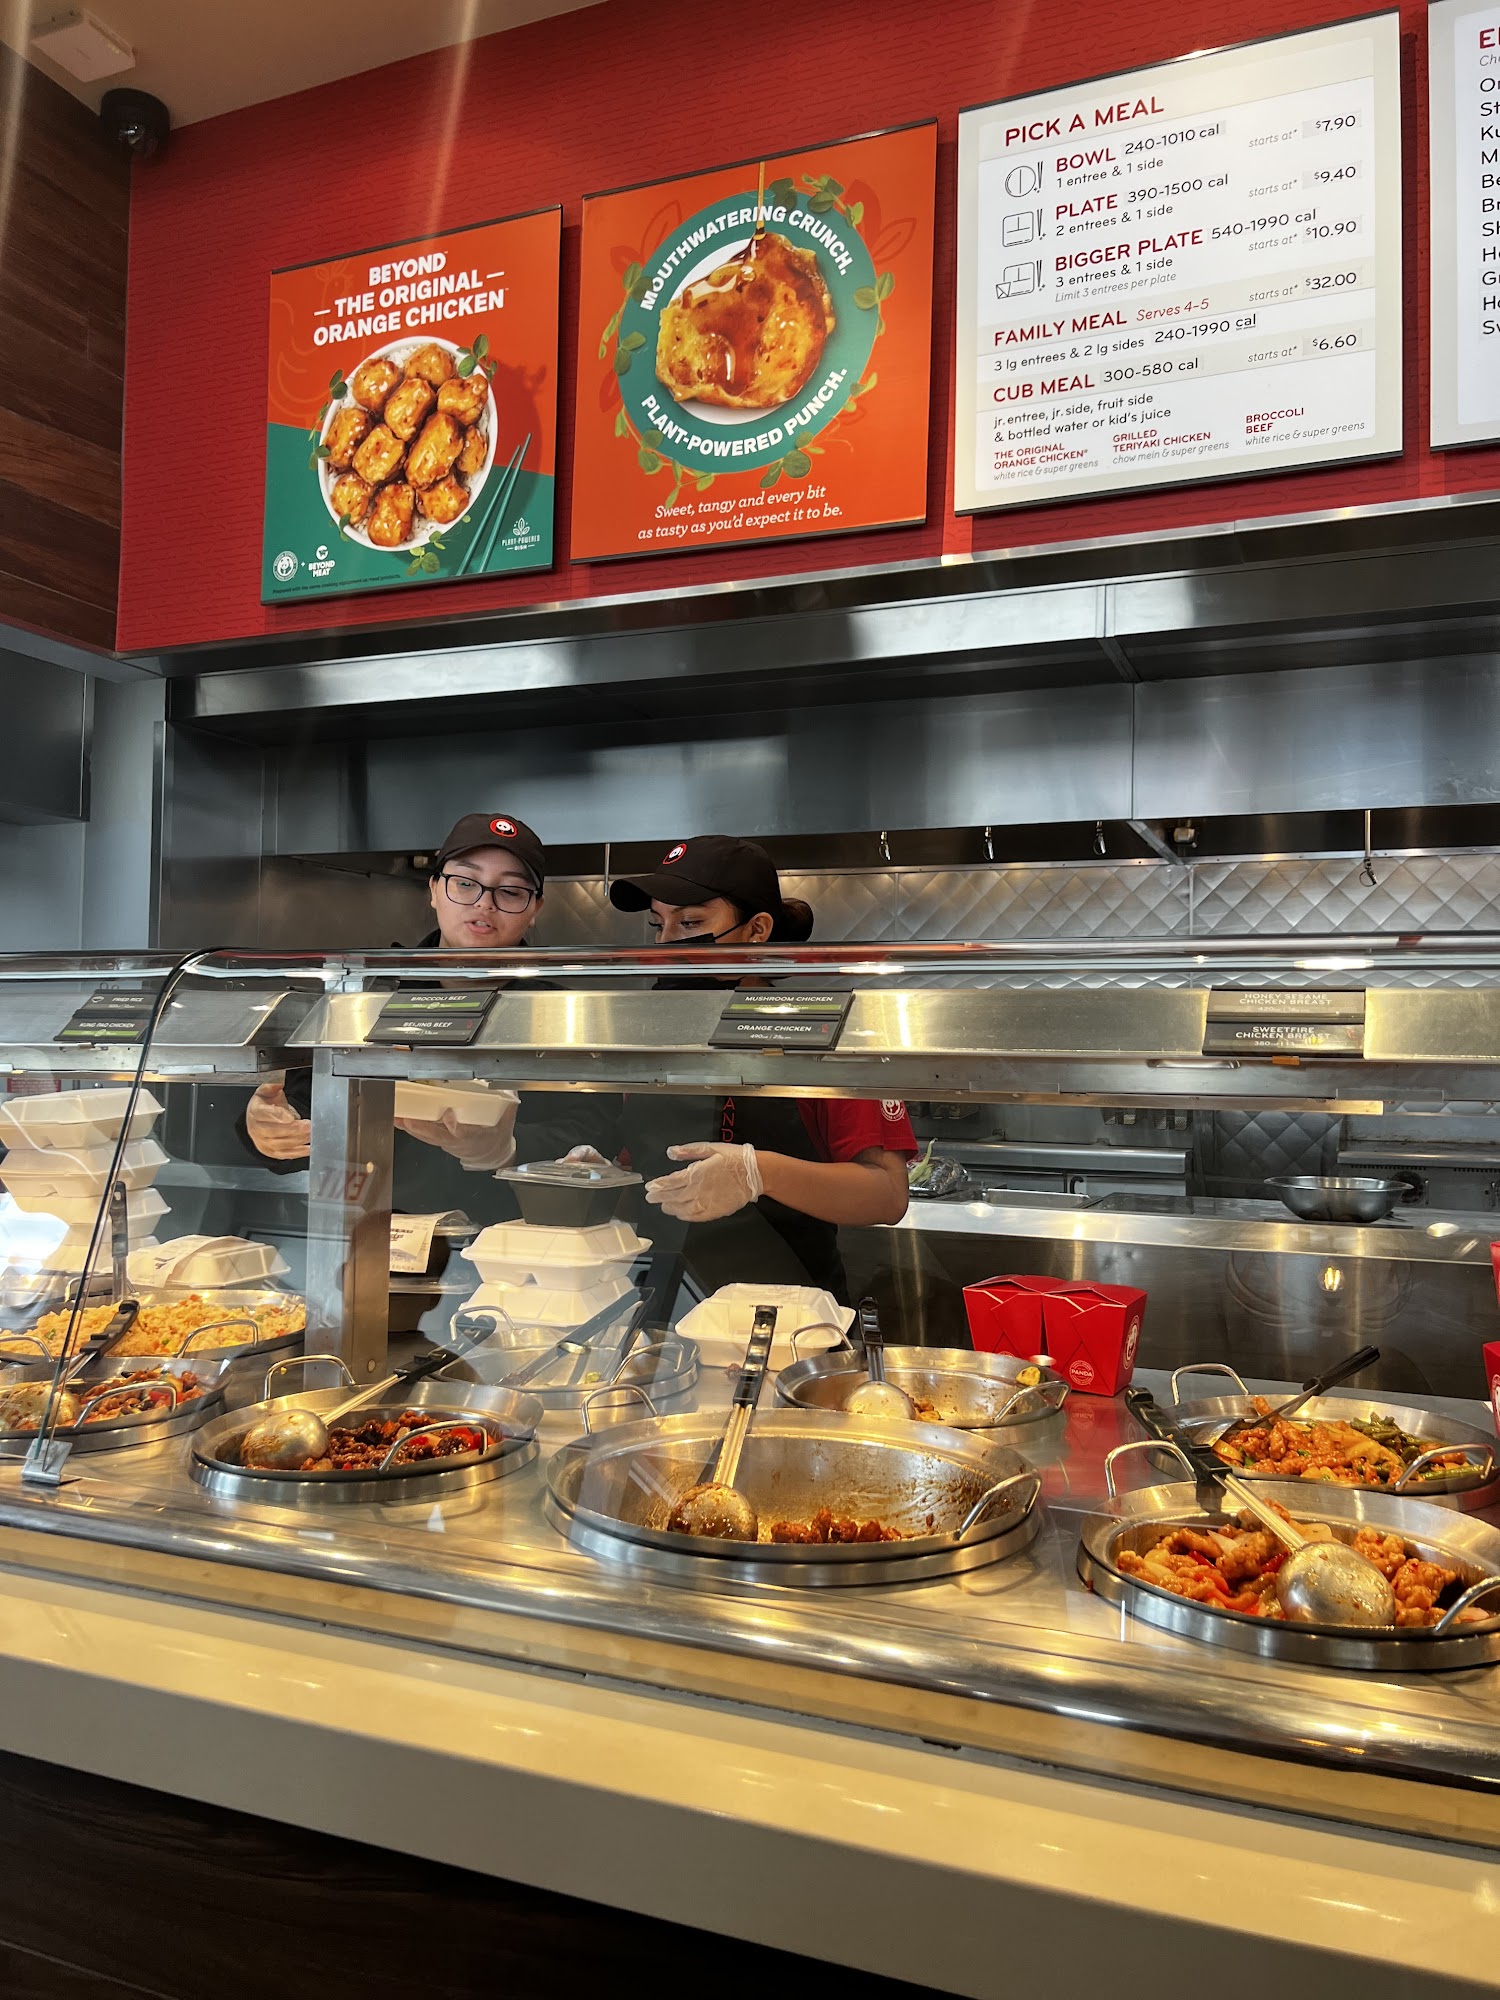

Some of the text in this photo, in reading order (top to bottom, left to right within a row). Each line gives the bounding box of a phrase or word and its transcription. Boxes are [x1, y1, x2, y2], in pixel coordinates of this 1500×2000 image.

[1005, 96, 1165, 147] PICK A MEAL
[1315, 114, 1356, 132] $7.90
[1056, 123, 1220, 173] BOWL 240-1010 cal
[1248, 134, 1279, 148] starts
[1057, 157, 1164, 189] 1 entree & 1 side
[1313, 166, 1356, 183] $9.40
[1055, 173, 1229, 220] PLATE 390-1500 cal
[1248, 185, 1279, 198] starts
[1056, 204, 1173, 237] 2 entrees & 1 side
[1305, 220, 1357, 239] $10.90
[1055, 208, 1317, 271] BIGGER PLATE 540-1990 cal
[1248, 238, 1279, 252] starts
[640, 205, 855, 311] MOUTHWATERING CRUNCH.
[1056, 256, 1173, 288] 3 entrees & 1 side
[1305, 271, 1357, 290] $32.00
[334, 269, 483, 317] THE ORIGINAL
[1055, 271, 1177, 303] Limit 3 entrees per plate
[1249, 289, 1280, 302] starts
[313, 311, 401, 346] ORANGE
[994, 297, 1210, 347] FAMILY MEAL Serves 4-5
[994, 313, 1257, 372] 3 lg entrees & 2 lg sides 240-1990 cal
[1312, 334, 1357, 351] $6.60
[1247, 350, 1279, 363] starts
[993, 357, 1199, 403] CUB MEAL 300-580 cal
[641, 368, 847, 457] PLANT-POWERED PUNCH.
[1097, 397, 1124, 411] fruit
[1128, 393, 1154, 406] side
[994, 408, 1171, 442] & bottled water or kid's juice
[1245, 407, 1305, 424] BROCCOLI
[1112, 429, 1158, 443] GRILLED
[1245, 422, 1274, 434] BEEF
[1245, 421, 1365, 446] white rice super greens
[994, 443, 1065, 460] THE ORIGINAL
[1112, 431, 1211, 454] TERIYAKI CHICKEN
[1112, 440, 1230, 465] chow mein super greens
[993, 454, 1037, 470] ORANGE
[993, 460, 1098, 481] white rice super greens
[655, 485, 826, 519] Sweet, tangy and every bit
[638, 502, 843, 540] as tasty as you'd expect it to be.
[308, 560, 336, 572] BEYOND
[312, 568, 331, 578] MEAT
[1071, 1368, 1093, 1377] PANDA
